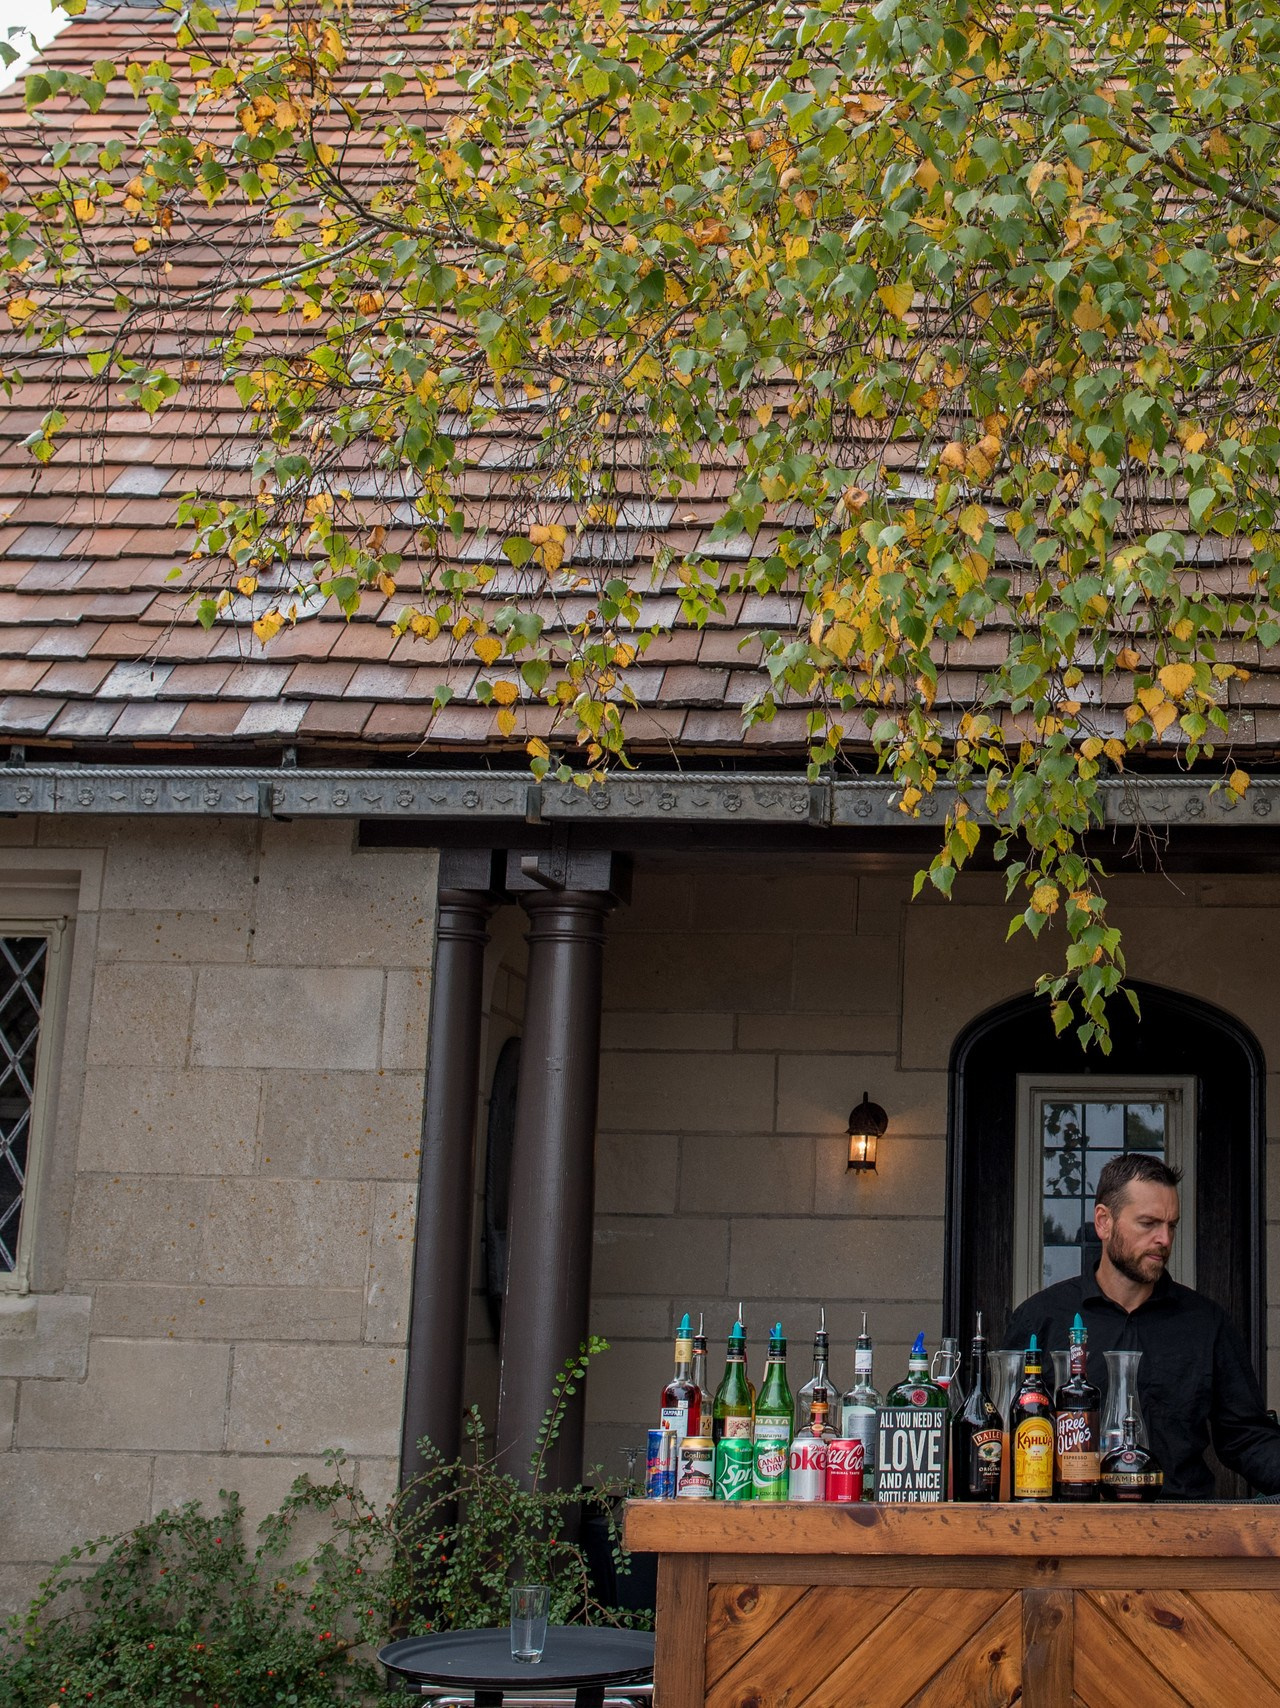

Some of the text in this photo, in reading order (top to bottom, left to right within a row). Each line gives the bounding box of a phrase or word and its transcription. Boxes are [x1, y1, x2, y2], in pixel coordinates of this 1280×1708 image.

[879, 1411, 942, 1428] ALL YOU NEED IS
[1017, 1431, 1053, 1450] KAHLÚA
[879, 1429, 942, 1471] LOVE
[656, 1458, 671, 1466] Bull
[789, 1446, 828, 1471] oke
[766, 1463, 783, 1473] DRY
[680, 1478, 699, 1486] GINGER
[879, 1472, 941, 1489] AND A NICE
[1104, 1475, 1156, 1483] CHAMBORD
[878, 1490, 940, 1502] BOTTLE OF WINE
